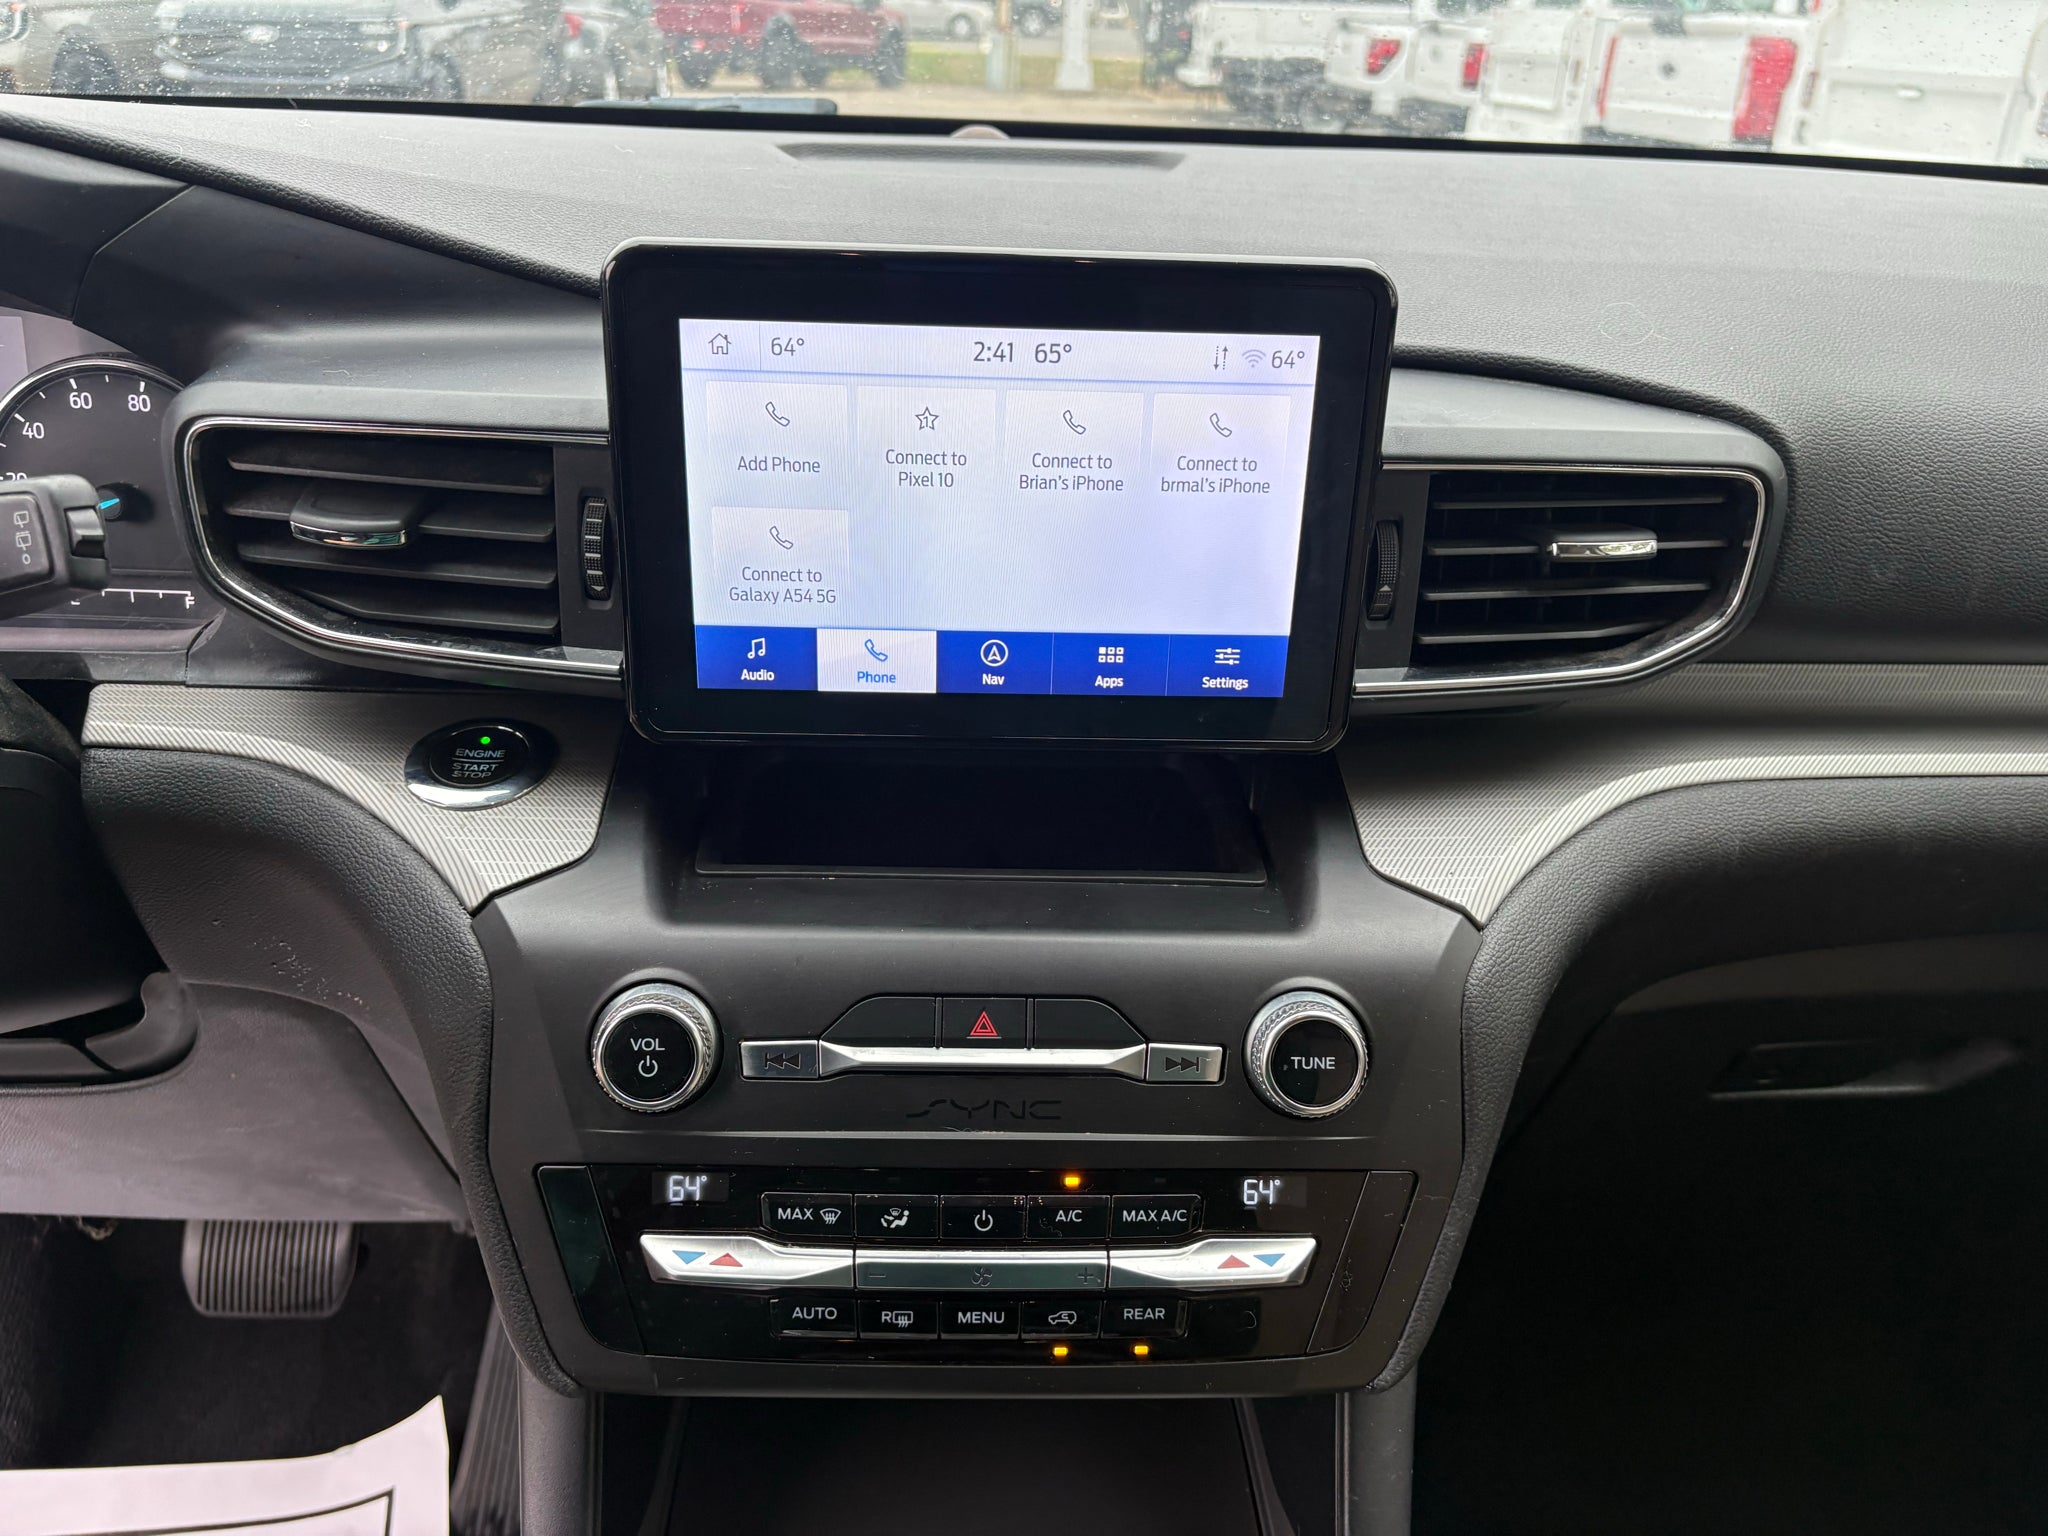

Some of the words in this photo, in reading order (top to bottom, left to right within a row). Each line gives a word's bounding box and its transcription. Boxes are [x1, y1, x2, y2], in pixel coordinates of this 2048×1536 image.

[771, 337, 805, 356] 64°
[973, 341, 1014, 363] 2:41
[1034, 343, 1073, 364] 65°
[1271, 350, 1306, 369] 64°
[69, 391, 93, 410] 60
[128, 394, 151, 412] 80
[22, 422, 45, 440] 40
[737, 456, 768, 472] Add
[772, 457, 821, 473] Phone
[885, 449, 948, 466] Connect
[951, 451, 968, 467] to
[1032, 453, 1094, 470] Connect
[1097, 454, 1113, 470] to
[1177, 455, 1239, 472] Connect
[1242, 457, 1258, 472] to
[898, 471, 934, 487] Pixel
[938, 472, 954, 488] 10
[1019, 474, 1070, 490] Brian's
[1072, 475, 1124, 491] iPhone
[1161, 477, 1216, 493] brmal's
[1218, 478, 1270, 494] iPhone
[742, 566, 803, 583] Connect
[806, 568, 823, 583] to
[185, 596, 195, 610] F
[729, 587, 780, 605] Galaxy
[783, 588, 813, 603] A54
[816, 589, 836, 604] 5G
[741, 668, 775, 682] Audio
[856, 671, 897, 684] Phone
[982, 673, 1005, 686] Nav
[1095, 675, 1124, 689] Apps
[1202, 676, 1249, 690] Settings
[455, 748, 506, 759] ENGINE
[452, 762, 499, 772] START
[452, 770, 491, 779] STOP
[630, 1037, 665, 1052] VOL
[1290, 1056, 1336, 1071] TUNE
[906, 1099, 1062, 1120] SYNC
[669, 1175, 708, 1202] 64°
[1243, 1178, 1281, 1205] 64°
[777, 1207, 814, 1221] MAX
[1055, 1209, 1083, 1224] A/C
[1122, 1209, 1158, 1223] MAX
[1160, 1209, 1188, 1223] A/C
[792, 1306, 838, 1321] AUTO
[957, 1312, 1005, 1325] MENU
[1123, 1307, 1166, 1321] REAR
